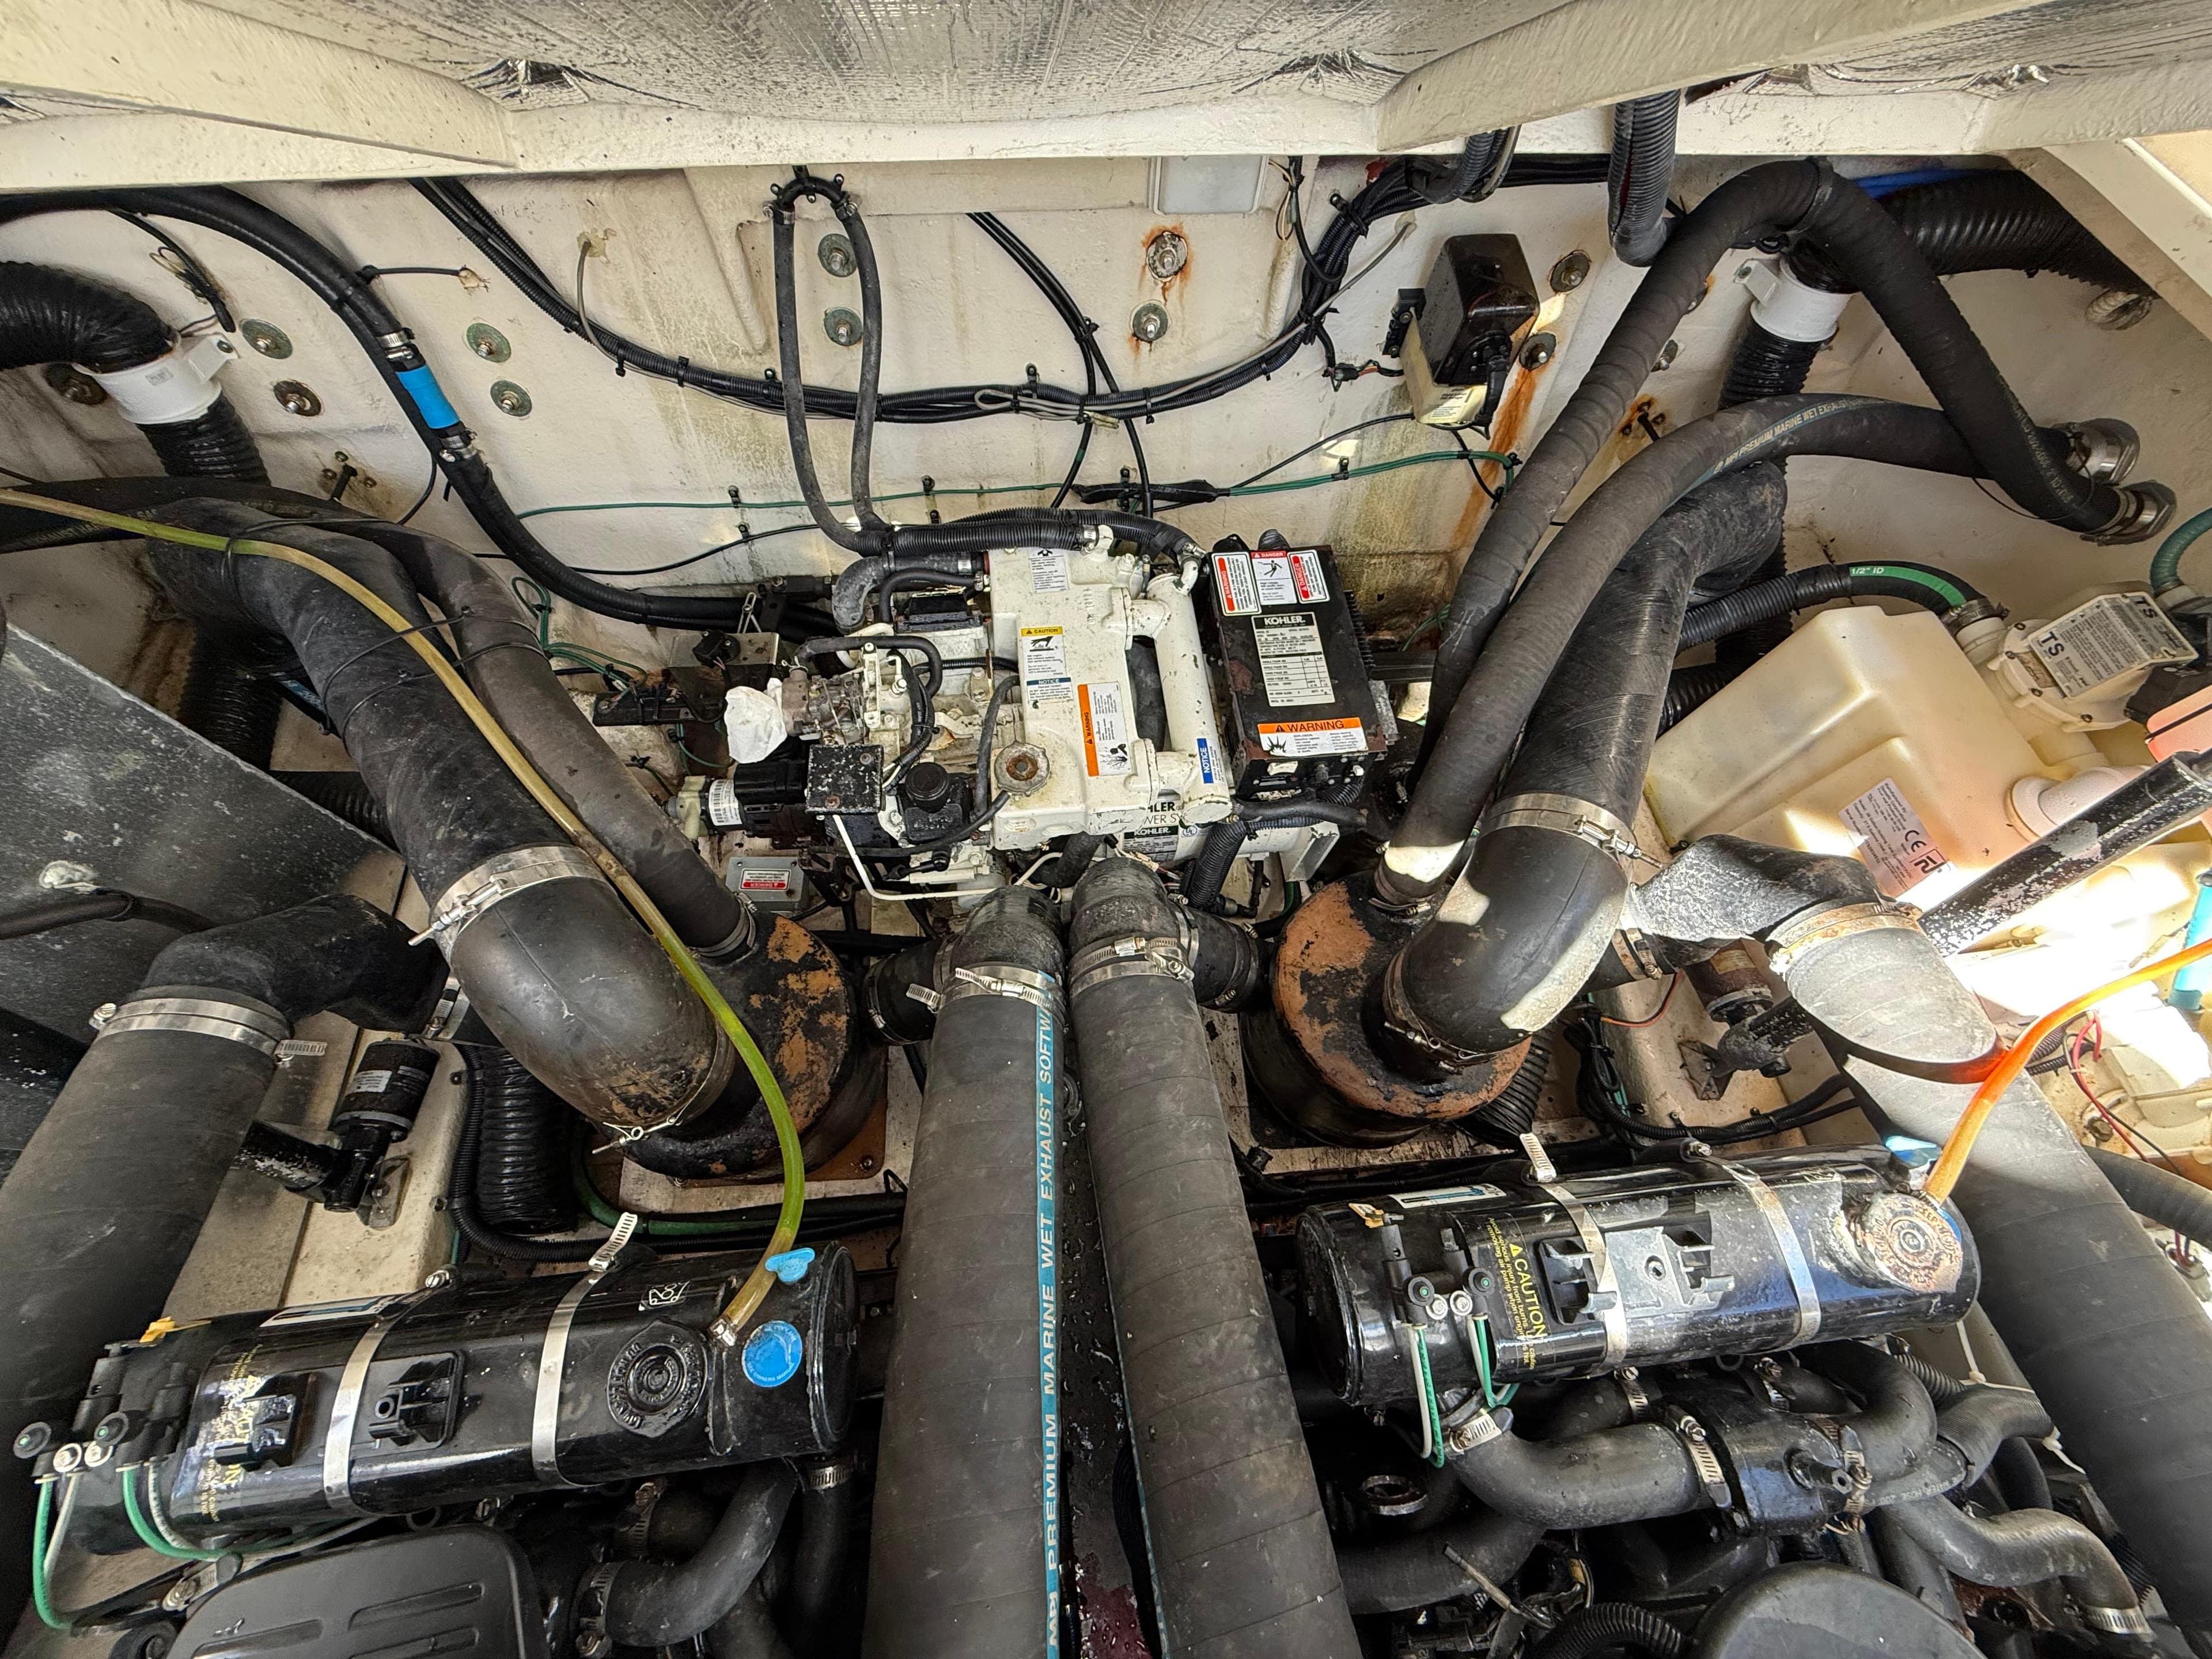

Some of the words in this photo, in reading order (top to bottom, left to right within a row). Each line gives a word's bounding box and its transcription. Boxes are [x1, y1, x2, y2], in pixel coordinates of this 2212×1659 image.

[1739, 429, 1774, 456] PREMIUM
[1774, 414, 1802, 436] MARINE
[1802, 407, 1818, 422] WET
[1221, 570, 1230, 594] WARNING
[1294, 562, 1305, 586] DANGER
[1287, 720, 1344, 732] WARNING
[1201, 747, 1210, 772] NOTICE
[1039, 1009, 1052, 1085] SOFTW
[1039, 1095, 1054, 1202] EXHAUST
[1040, 1212, 1055, 1270] WET
[1486, 1225, 1501, 1260] removing
[1500, 1269, 1510, 1292] pump
[1497, 1232, 1509, 1263] serious
[1504, 1263, 1516, 1286] injury
[1513, 1285, 1521, 1307] from
[1514, 1258, 1548, 1338] CAUTION
[1041, 1283, 1056, 1396] MARINE
[776, 1362, 794, 1380] MANUAL
[1044, 1414, 1059, 1571] PREMIUM
[1048, 1591, 1058, 1648] MPI
